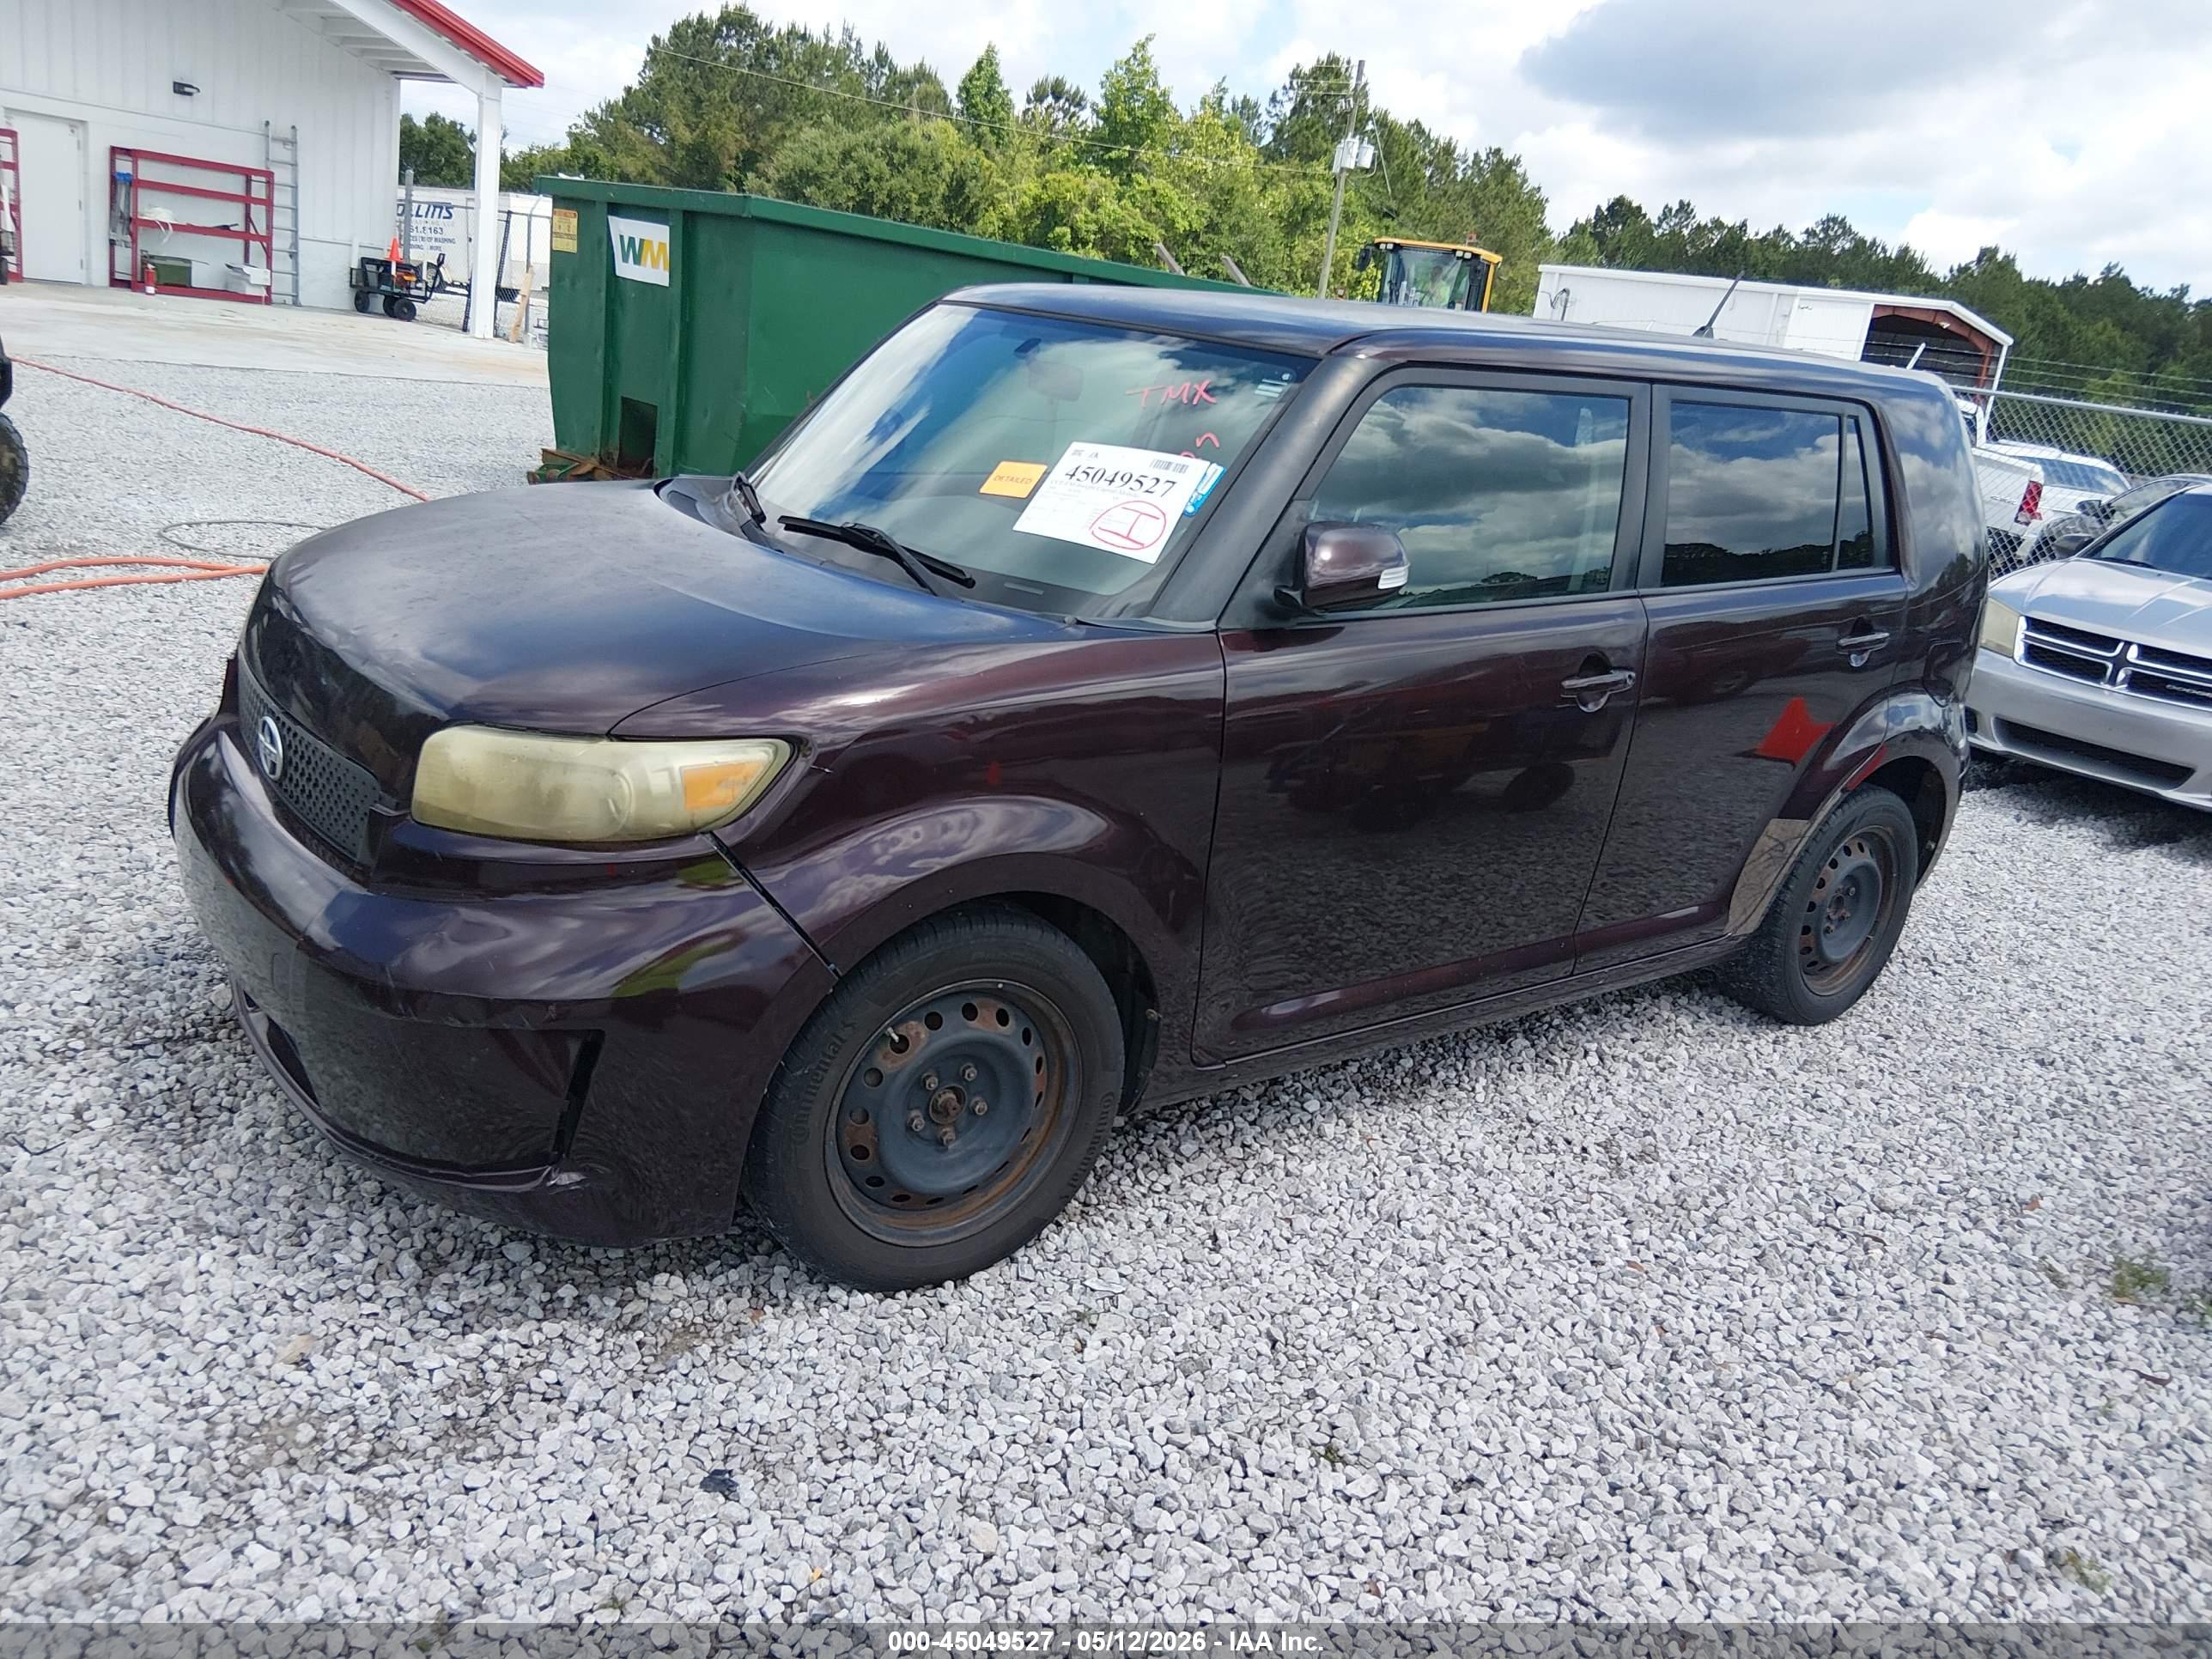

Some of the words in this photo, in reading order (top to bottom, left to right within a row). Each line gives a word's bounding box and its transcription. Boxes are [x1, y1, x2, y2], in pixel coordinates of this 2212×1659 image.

[618, 234, 670, 272] WM
[1126, 379, 1218, 409] TMX
[993, 474, 1032, 486] DETAILED
[1065, 465, 1177, 498] 45049527
